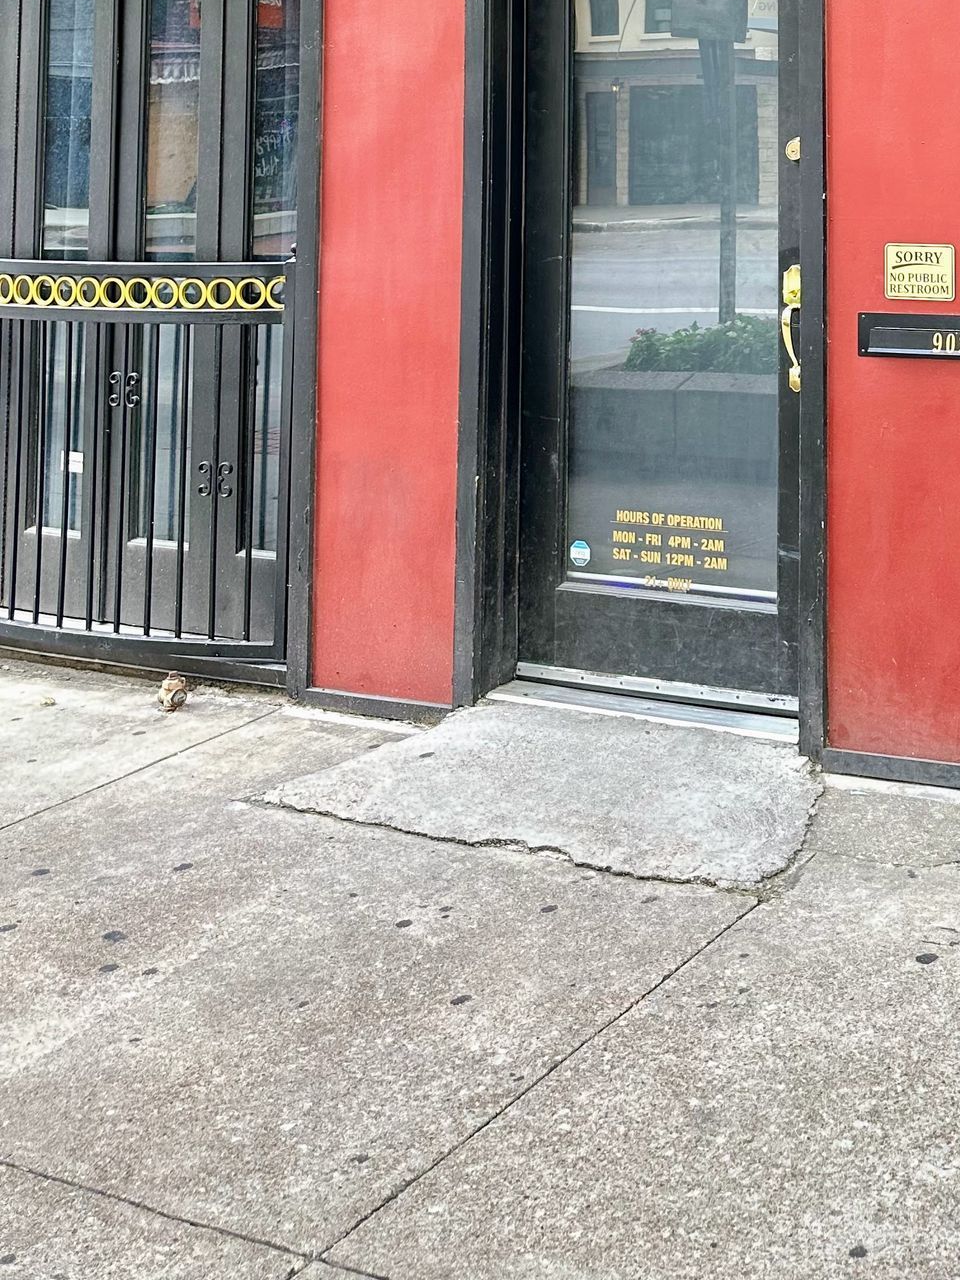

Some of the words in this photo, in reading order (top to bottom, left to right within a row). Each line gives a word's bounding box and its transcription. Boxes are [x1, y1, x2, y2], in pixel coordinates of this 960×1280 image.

[895, 251, 943, 264] SORRY
[890, 272, 905, 282] NO
[908, 273, 948, 283] PUBLIC
[889, 283, 949, 295] RESTROOM
[616, 510, 650, 524] HOURS
[652, 513, 665, 524] OF
[667, 514, 723, 530] OPERATION
[612, 530, 636, 543] MON
[646, 533, 662, 546] FRI
[668, 535, 691, 549] 4PM
[701, 539, 724, 552] 2AM
[612, 548, 631, 560] SAT
[641, 551, 661, 564] SUN
[665, 553, 694, 567] 12PM
[704, 557, 727, 570] 2AM
